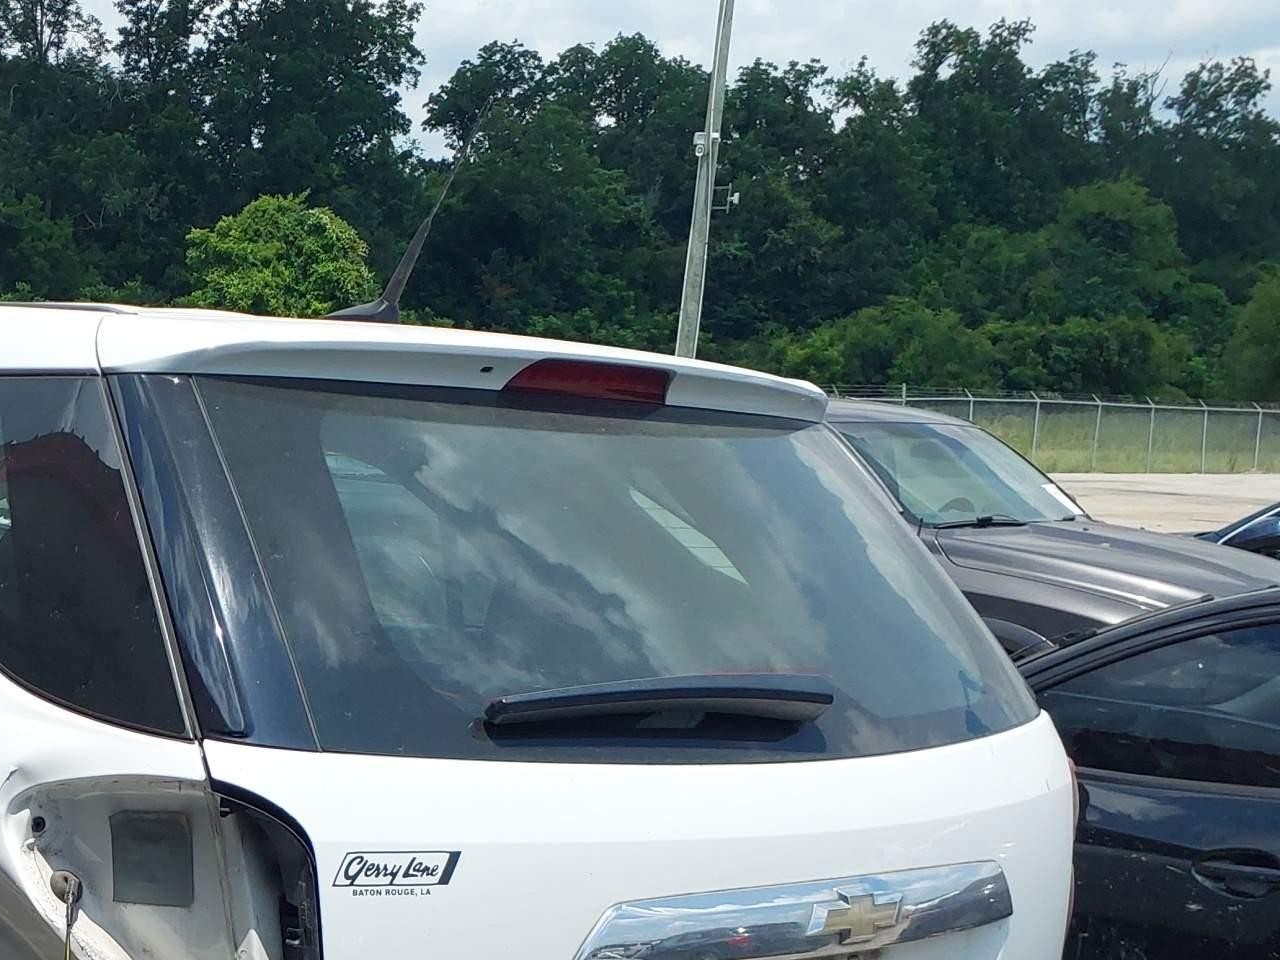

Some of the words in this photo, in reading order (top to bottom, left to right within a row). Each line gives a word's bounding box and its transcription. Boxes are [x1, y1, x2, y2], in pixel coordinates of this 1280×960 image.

[343, 855, 402, 885] Gerry
[402, 857, 440, 878] Lane
[352, 888, 382, 897] BATON
[385, 888, 418, 897] ROUGE,
[420, 888, 431, 896] LA
